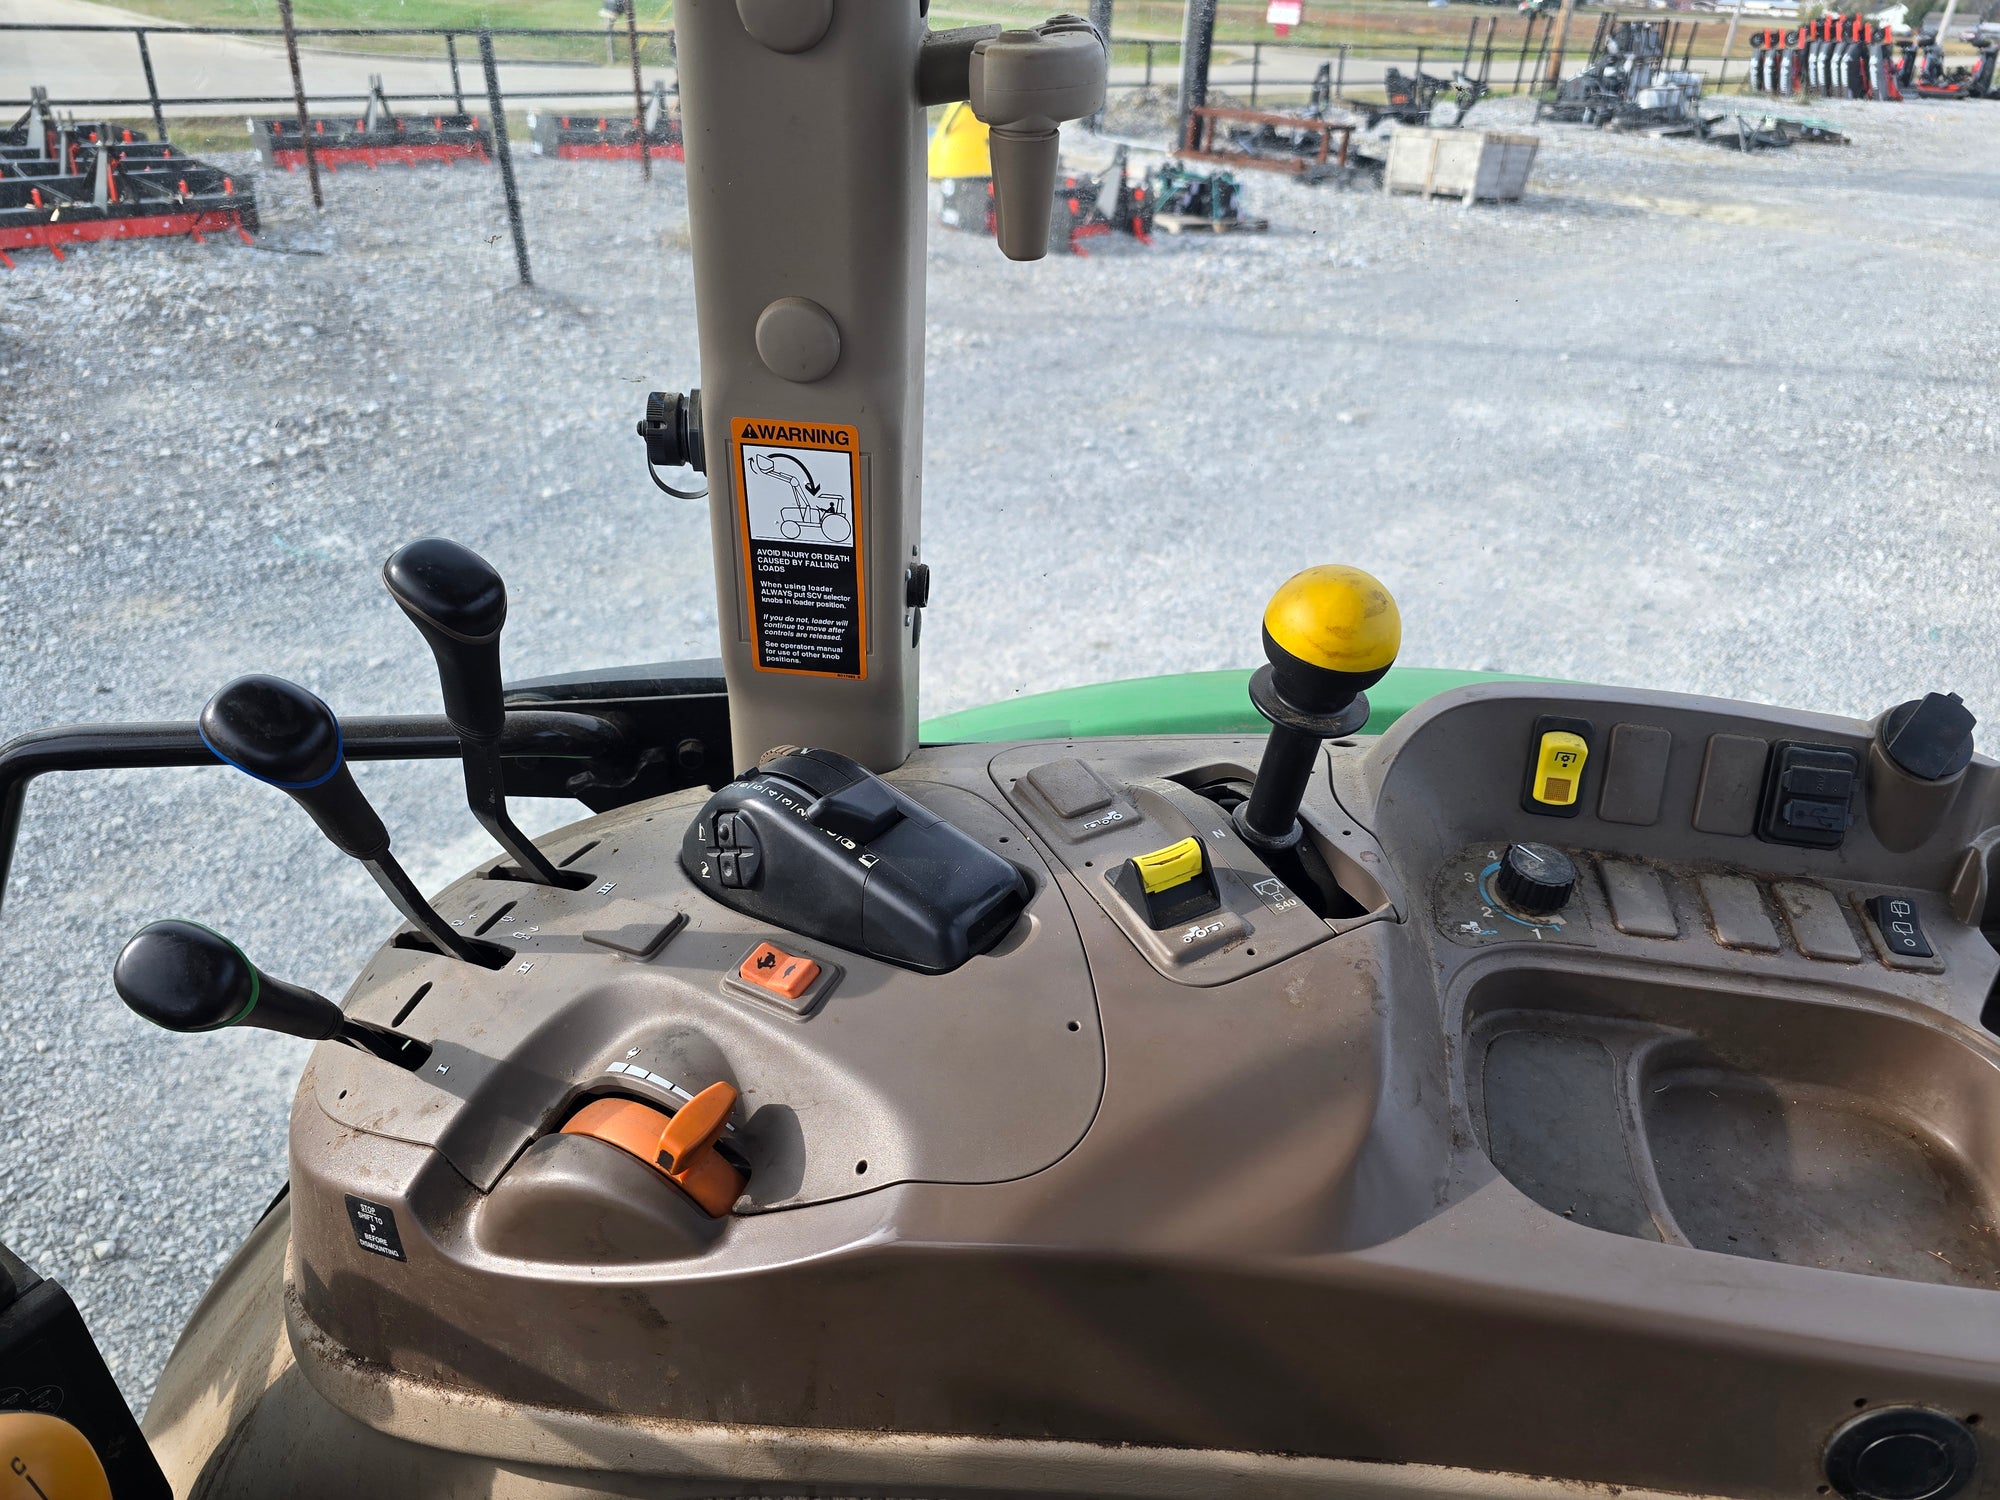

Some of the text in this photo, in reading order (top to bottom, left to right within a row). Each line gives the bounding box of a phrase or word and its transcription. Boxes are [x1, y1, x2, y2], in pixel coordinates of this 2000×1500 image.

[758, 425, 849, 446] WARNING
[757, 557, 790, 565] CAUSED
[805, 561, 839, 569] FALLING
[824, 554, 850, 562] DEATH
[784, 583, 806, 591] using
[761, 589, 792, 597] ALWAYS
[766, 656, 801, 664] positions.
[768, 789, 779, 797] 4
[782, 797, 793, 806] 3
[796, 808, 807, 817] 2
[1212, 829, 1226, 839] N
[1487, 850, 1498, 860] 4
[1463, 872, 1476, 883] 3
[1275, 898, 1297, 911] 540
[1481, 906, 1494, 918] 2
[1531, 928, 1542, 940] 1
[360, 1204, 375, 1213] STOP
[374, 1217, 383, 1225] TO
[370, 1224, 376, 1233] P
[364, 1233, 388, 1246] BEFORE
